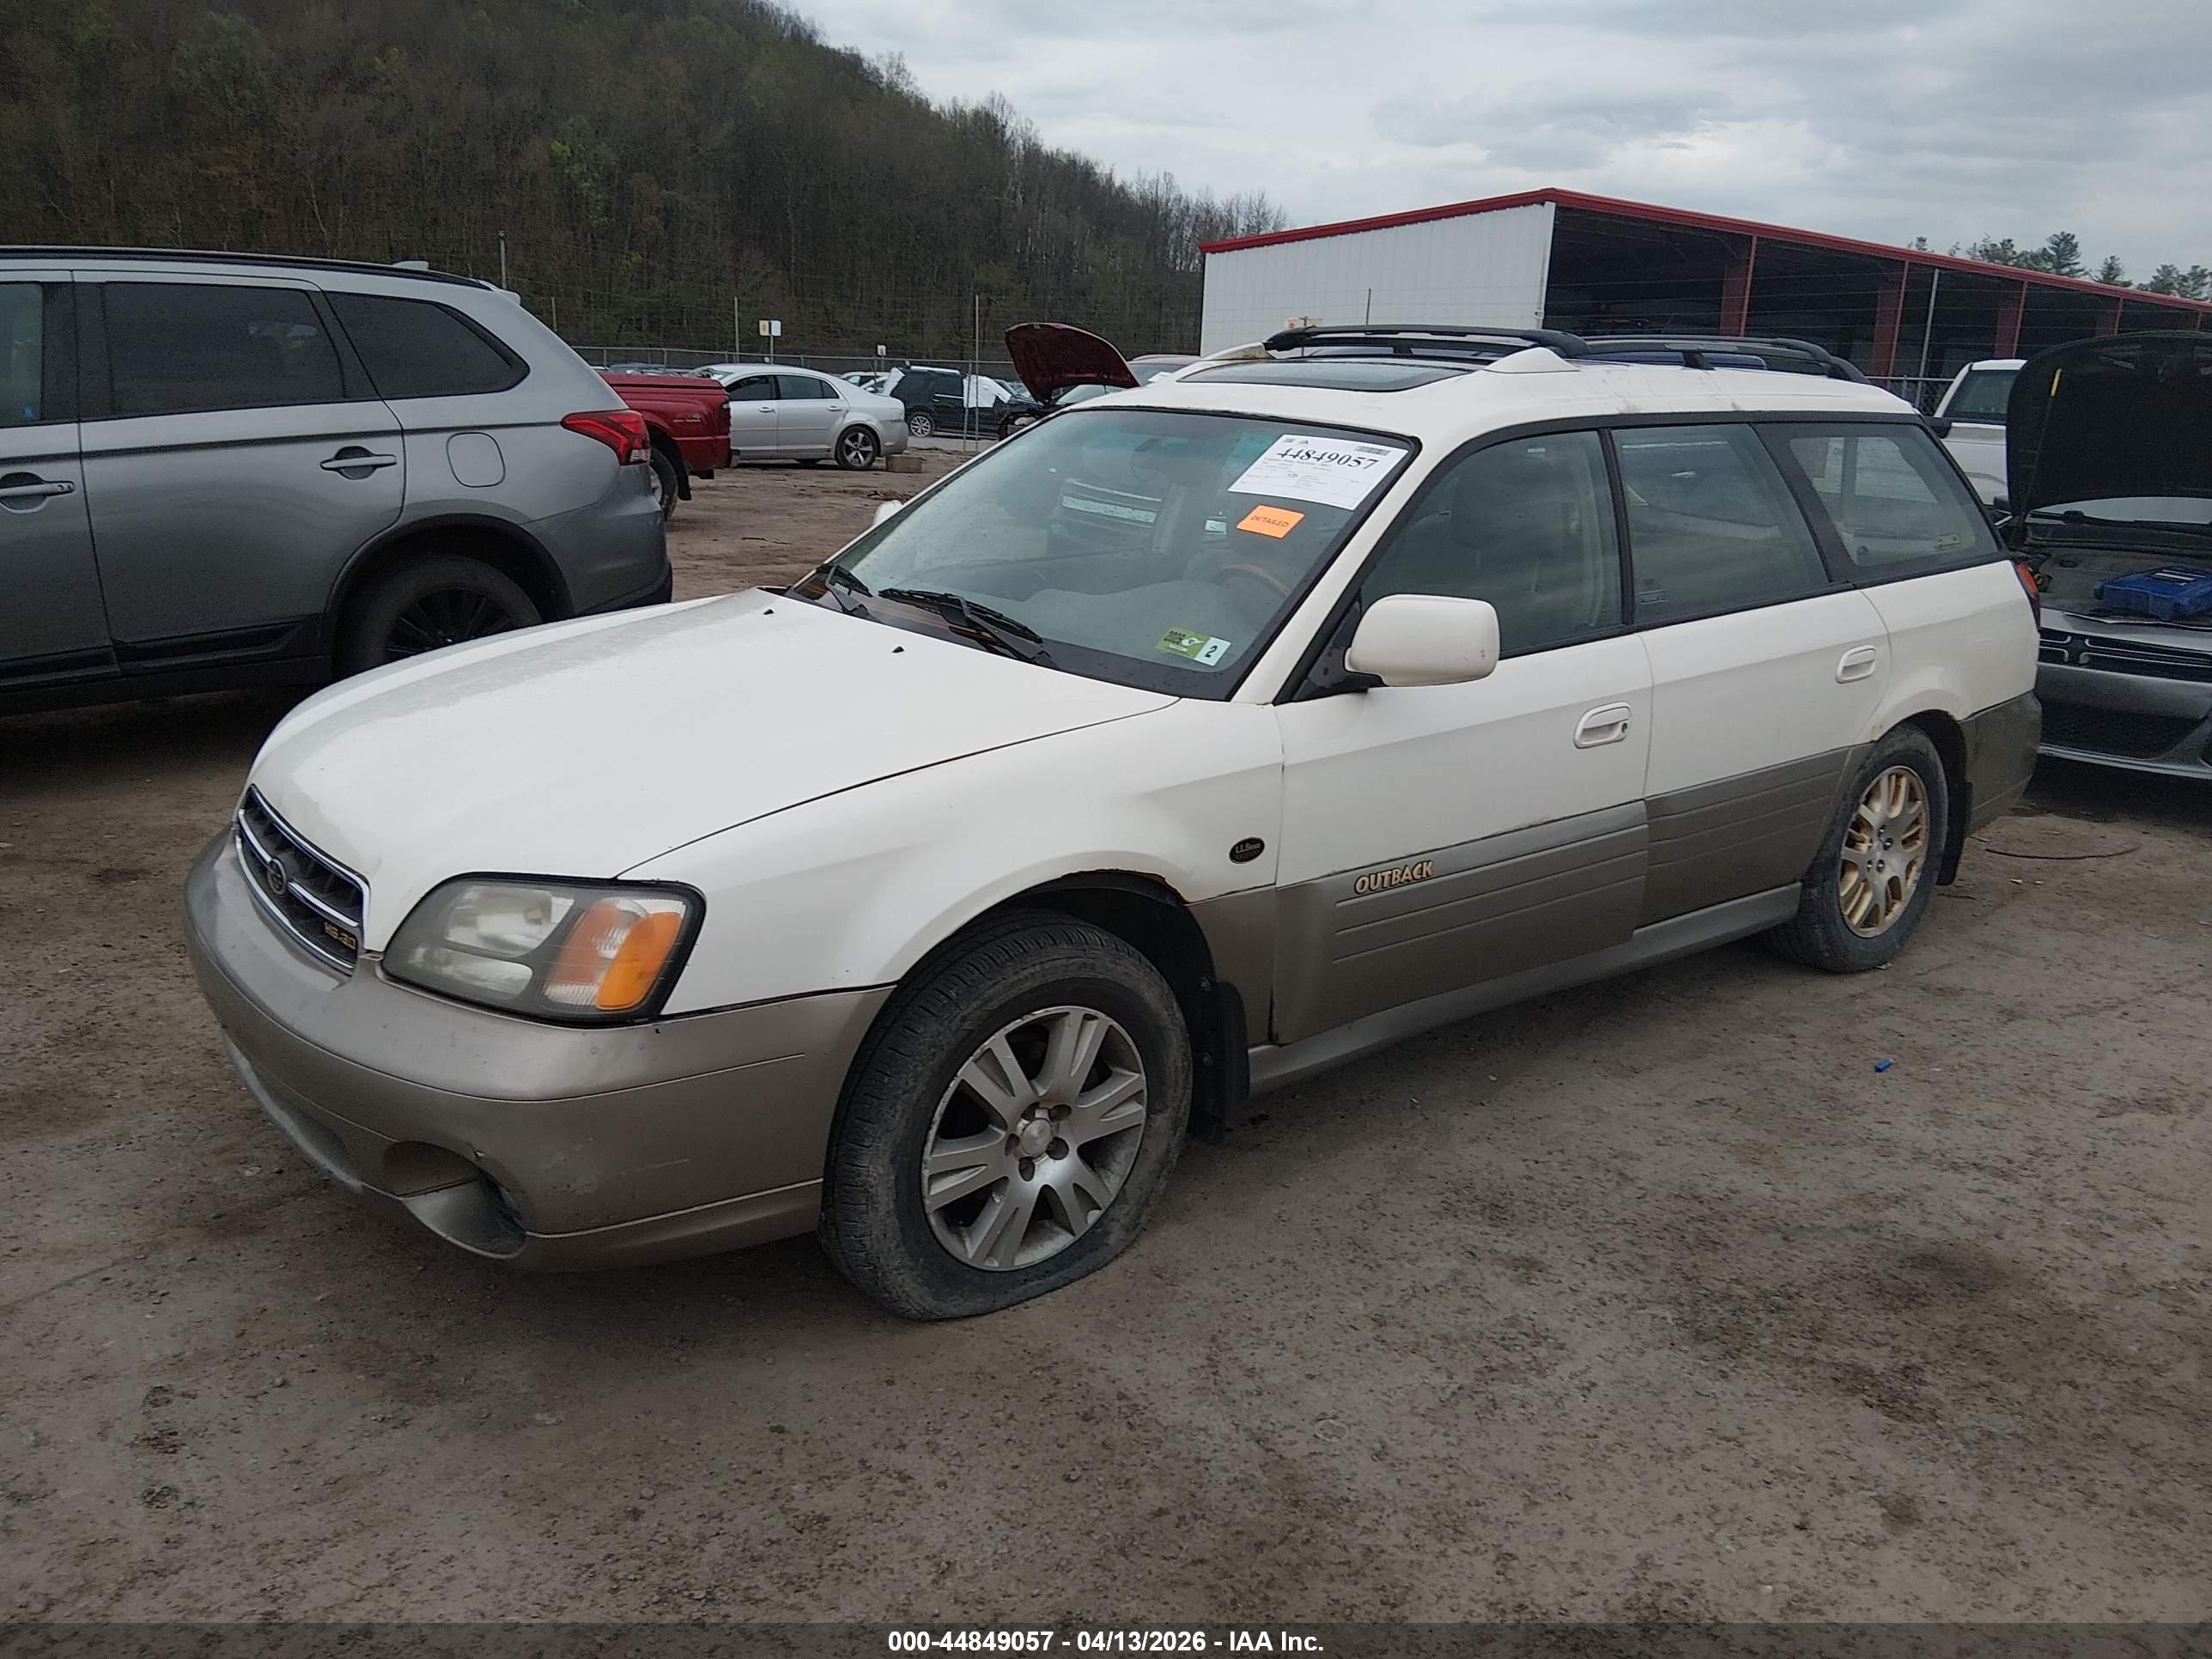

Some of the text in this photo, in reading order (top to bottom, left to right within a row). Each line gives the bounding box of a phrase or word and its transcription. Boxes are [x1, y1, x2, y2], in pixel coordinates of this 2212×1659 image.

[1277, 447, 1379, 470] 44849057
[1249, 514, 1290, 527] DETAILED
[1204, 645, 1218, 659] 2
[1353, 860, 1433, 894] OUTBACK
